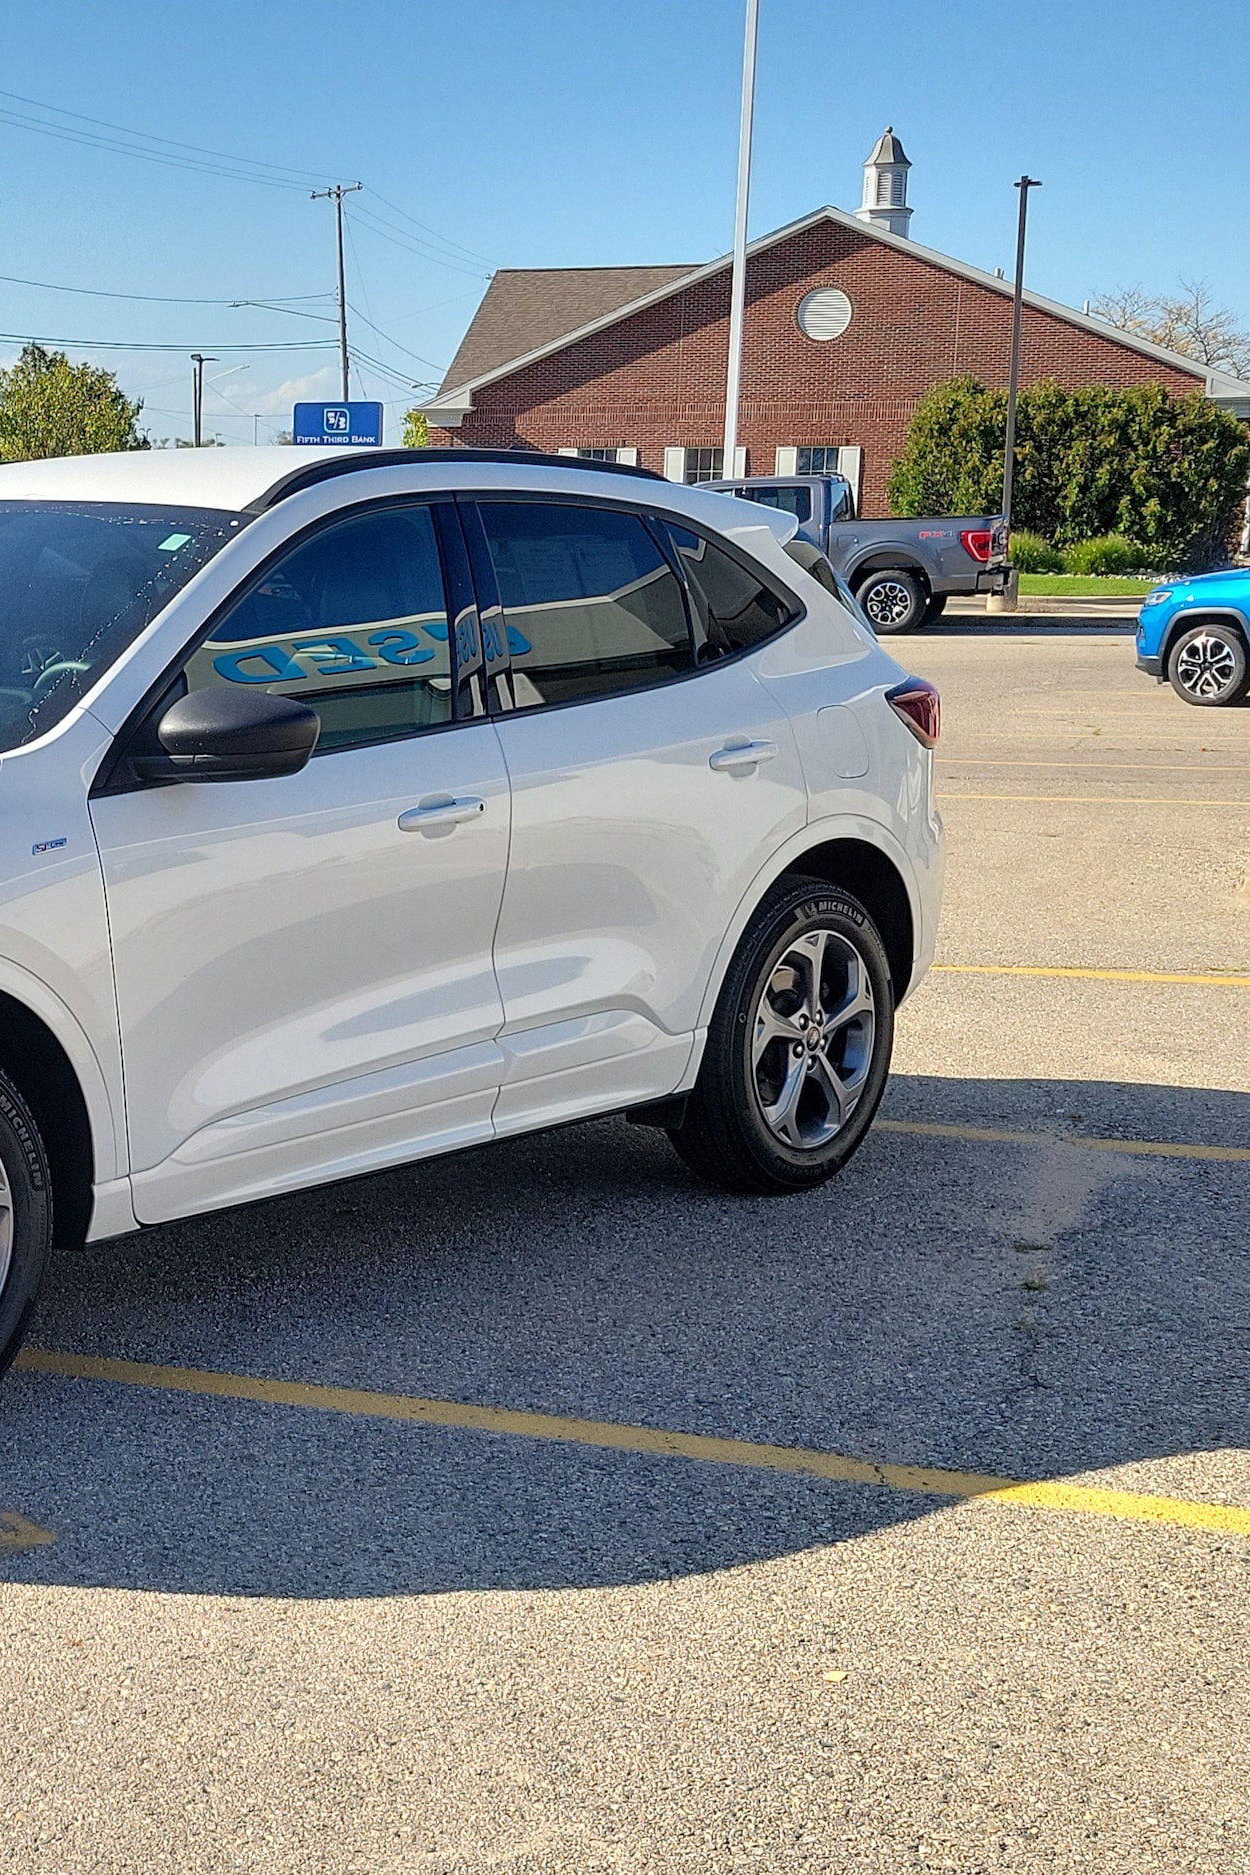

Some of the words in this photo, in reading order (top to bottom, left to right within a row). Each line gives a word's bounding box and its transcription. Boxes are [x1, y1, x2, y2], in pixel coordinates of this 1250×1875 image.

[296, 435, 320, 444] FIFTH
[322, 435, 349, 444] THIRD
[351, 435, 376, 444] BANK
[919, 530, 953, 540] FX4
[818, 901, 864, 924] MICHELIN
